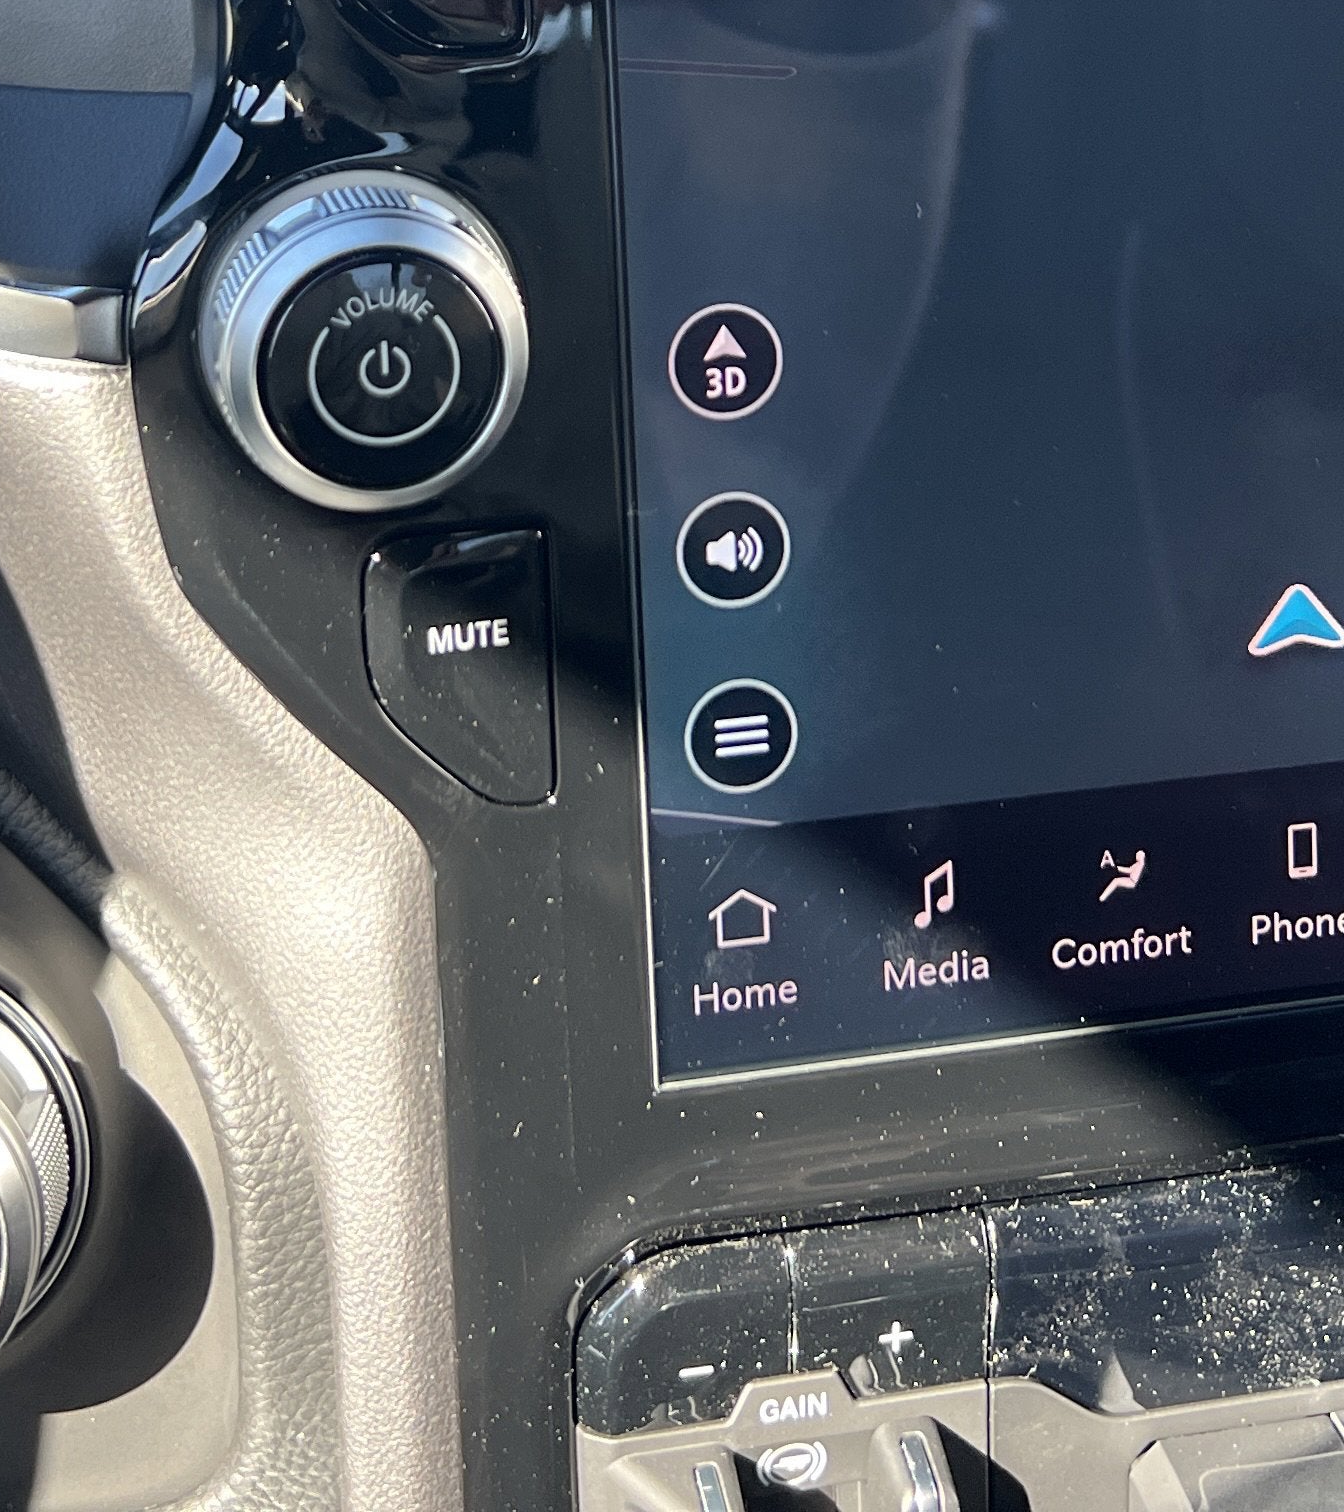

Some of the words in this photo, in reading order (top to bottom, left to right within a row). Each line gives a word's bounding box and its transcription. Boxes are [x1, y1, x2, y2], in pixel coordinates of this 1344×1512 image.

[329, 287, 436, 331] VOLUME
[704, 366, 748, 399] 3D
[426, 616, 511, 656] MUTE
[1052, 926, 1193, 969] Comfort
[882, 951, 990, 992] Media
[692, 974, 799, 1016] Home
[758, 1391, 829, 1424] GAIN
